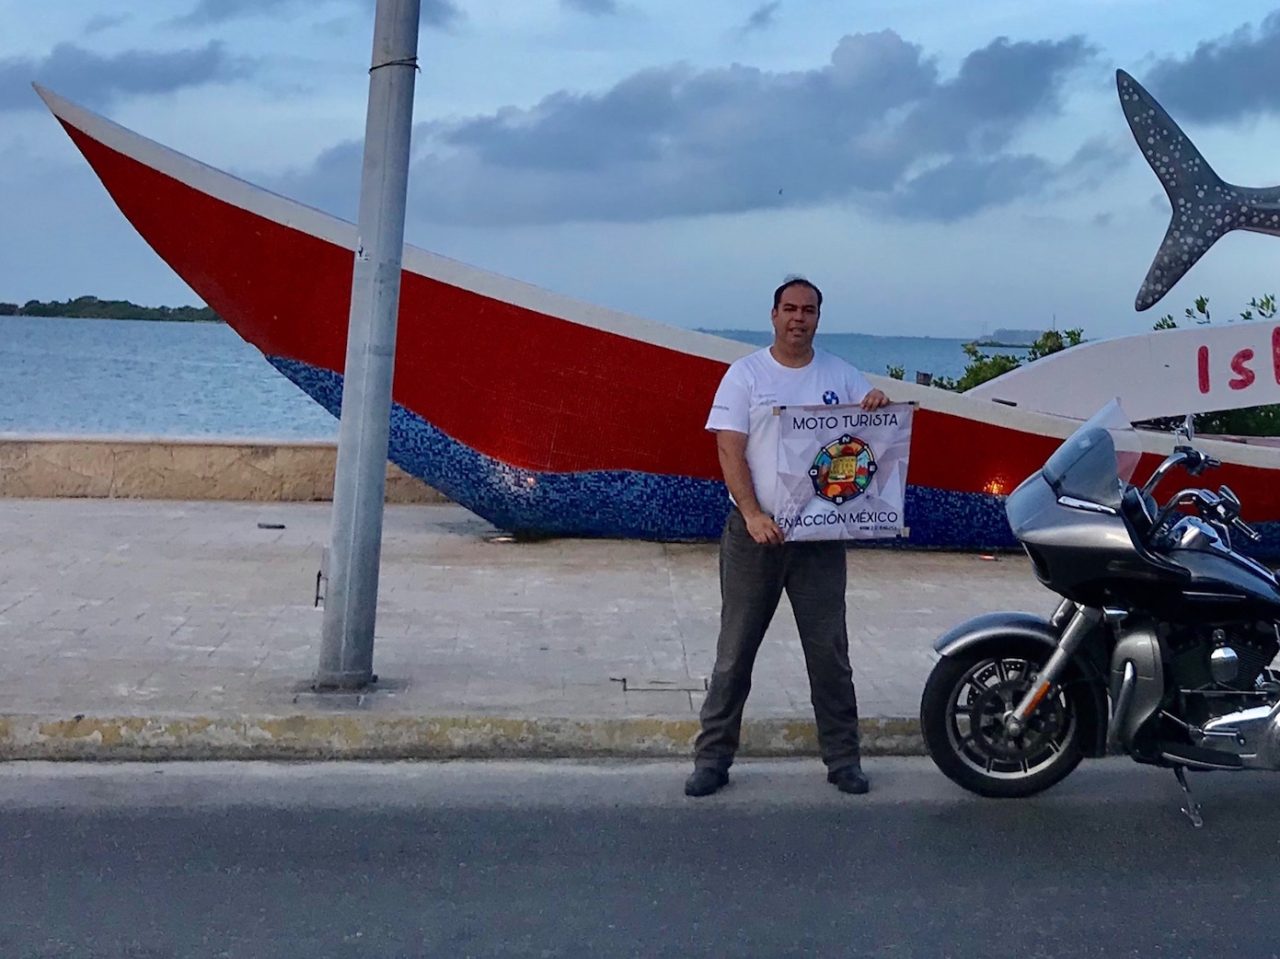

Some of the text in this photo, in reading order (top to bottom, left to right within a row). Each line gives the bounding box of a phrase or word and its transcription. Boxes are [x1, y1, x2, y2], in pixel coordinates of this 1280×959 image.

[793, 414, 898, 430] MOTO TURISTA
[779, 509, 898, 528] EN ACCIÓN MÉXICO
